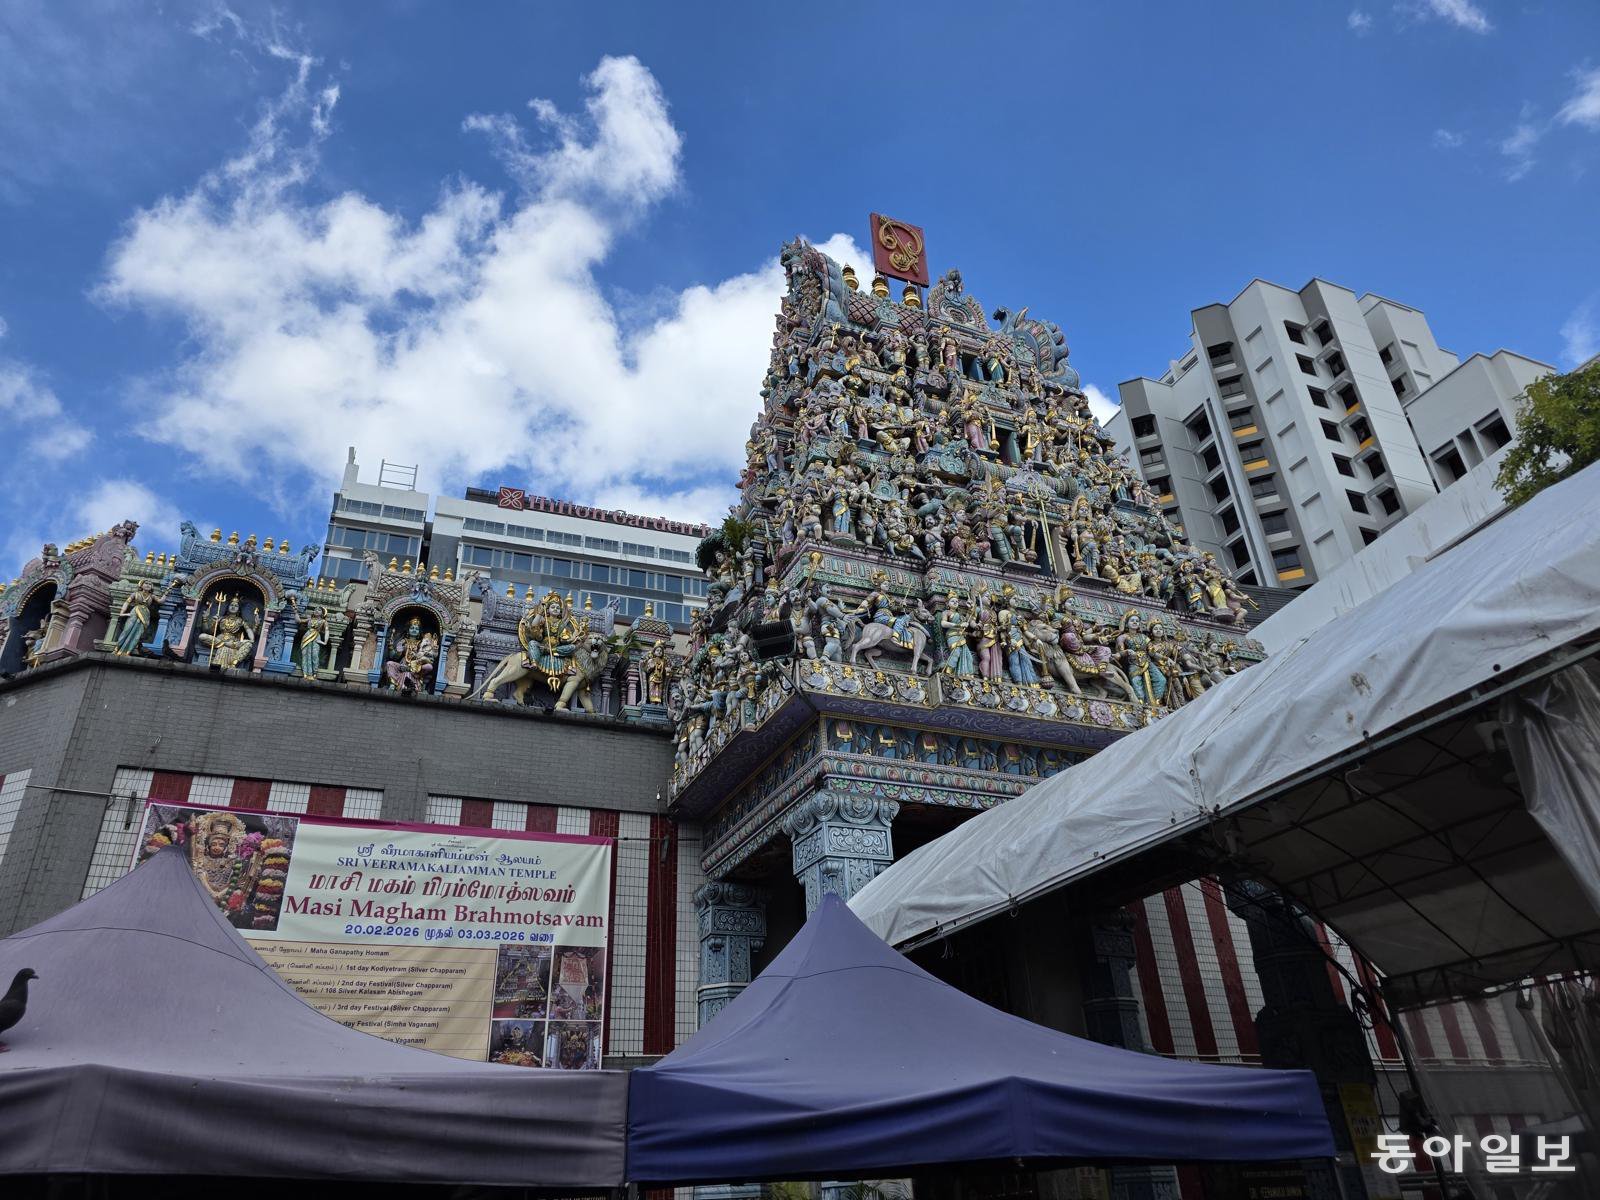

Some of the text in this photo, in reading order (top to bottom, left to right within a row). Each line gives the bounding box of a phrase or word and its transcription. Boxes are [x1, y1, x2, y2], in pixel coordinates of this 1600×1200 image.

[528, 494, 607, 521] Hilton
[612, 509, 693, 535] Garden
[496, 853, 542, 866] ஆலயம்
[337, 857, 557, 880] SRI VEERAMAKALIAMMAN TEMPLE
[309, 871, 363, 892] மாசி
[367, 875, 417, 895] மகம்
[284, 895, 604, 928] Masi Magham Brahmotsavam
[345, 924, 555, 943] 20.02.2026 முதல் 03.03.2026 வரை
[310, 947, 328, 955] Maha
[329, 948, 364, 956] Ganapathy
[357, 965, 369, 973] day
[370, 965, 407, 974] Kodiyetram
[408, 966, 428, 974] (Silver
[430, 967, 467, 976] Chapparam)
[355, 980, 367, 988] day
[416, 981, 453, 990] Chapparam)
[358, 988, 386, 996] Kalasam
[387, 989, 423, 997] Abishegam
[350, 1004, 361, 1012] day
[412, 1005, 450, 1013] Chapparam)
[408, 1021, 439, 1029] Vaganam)
